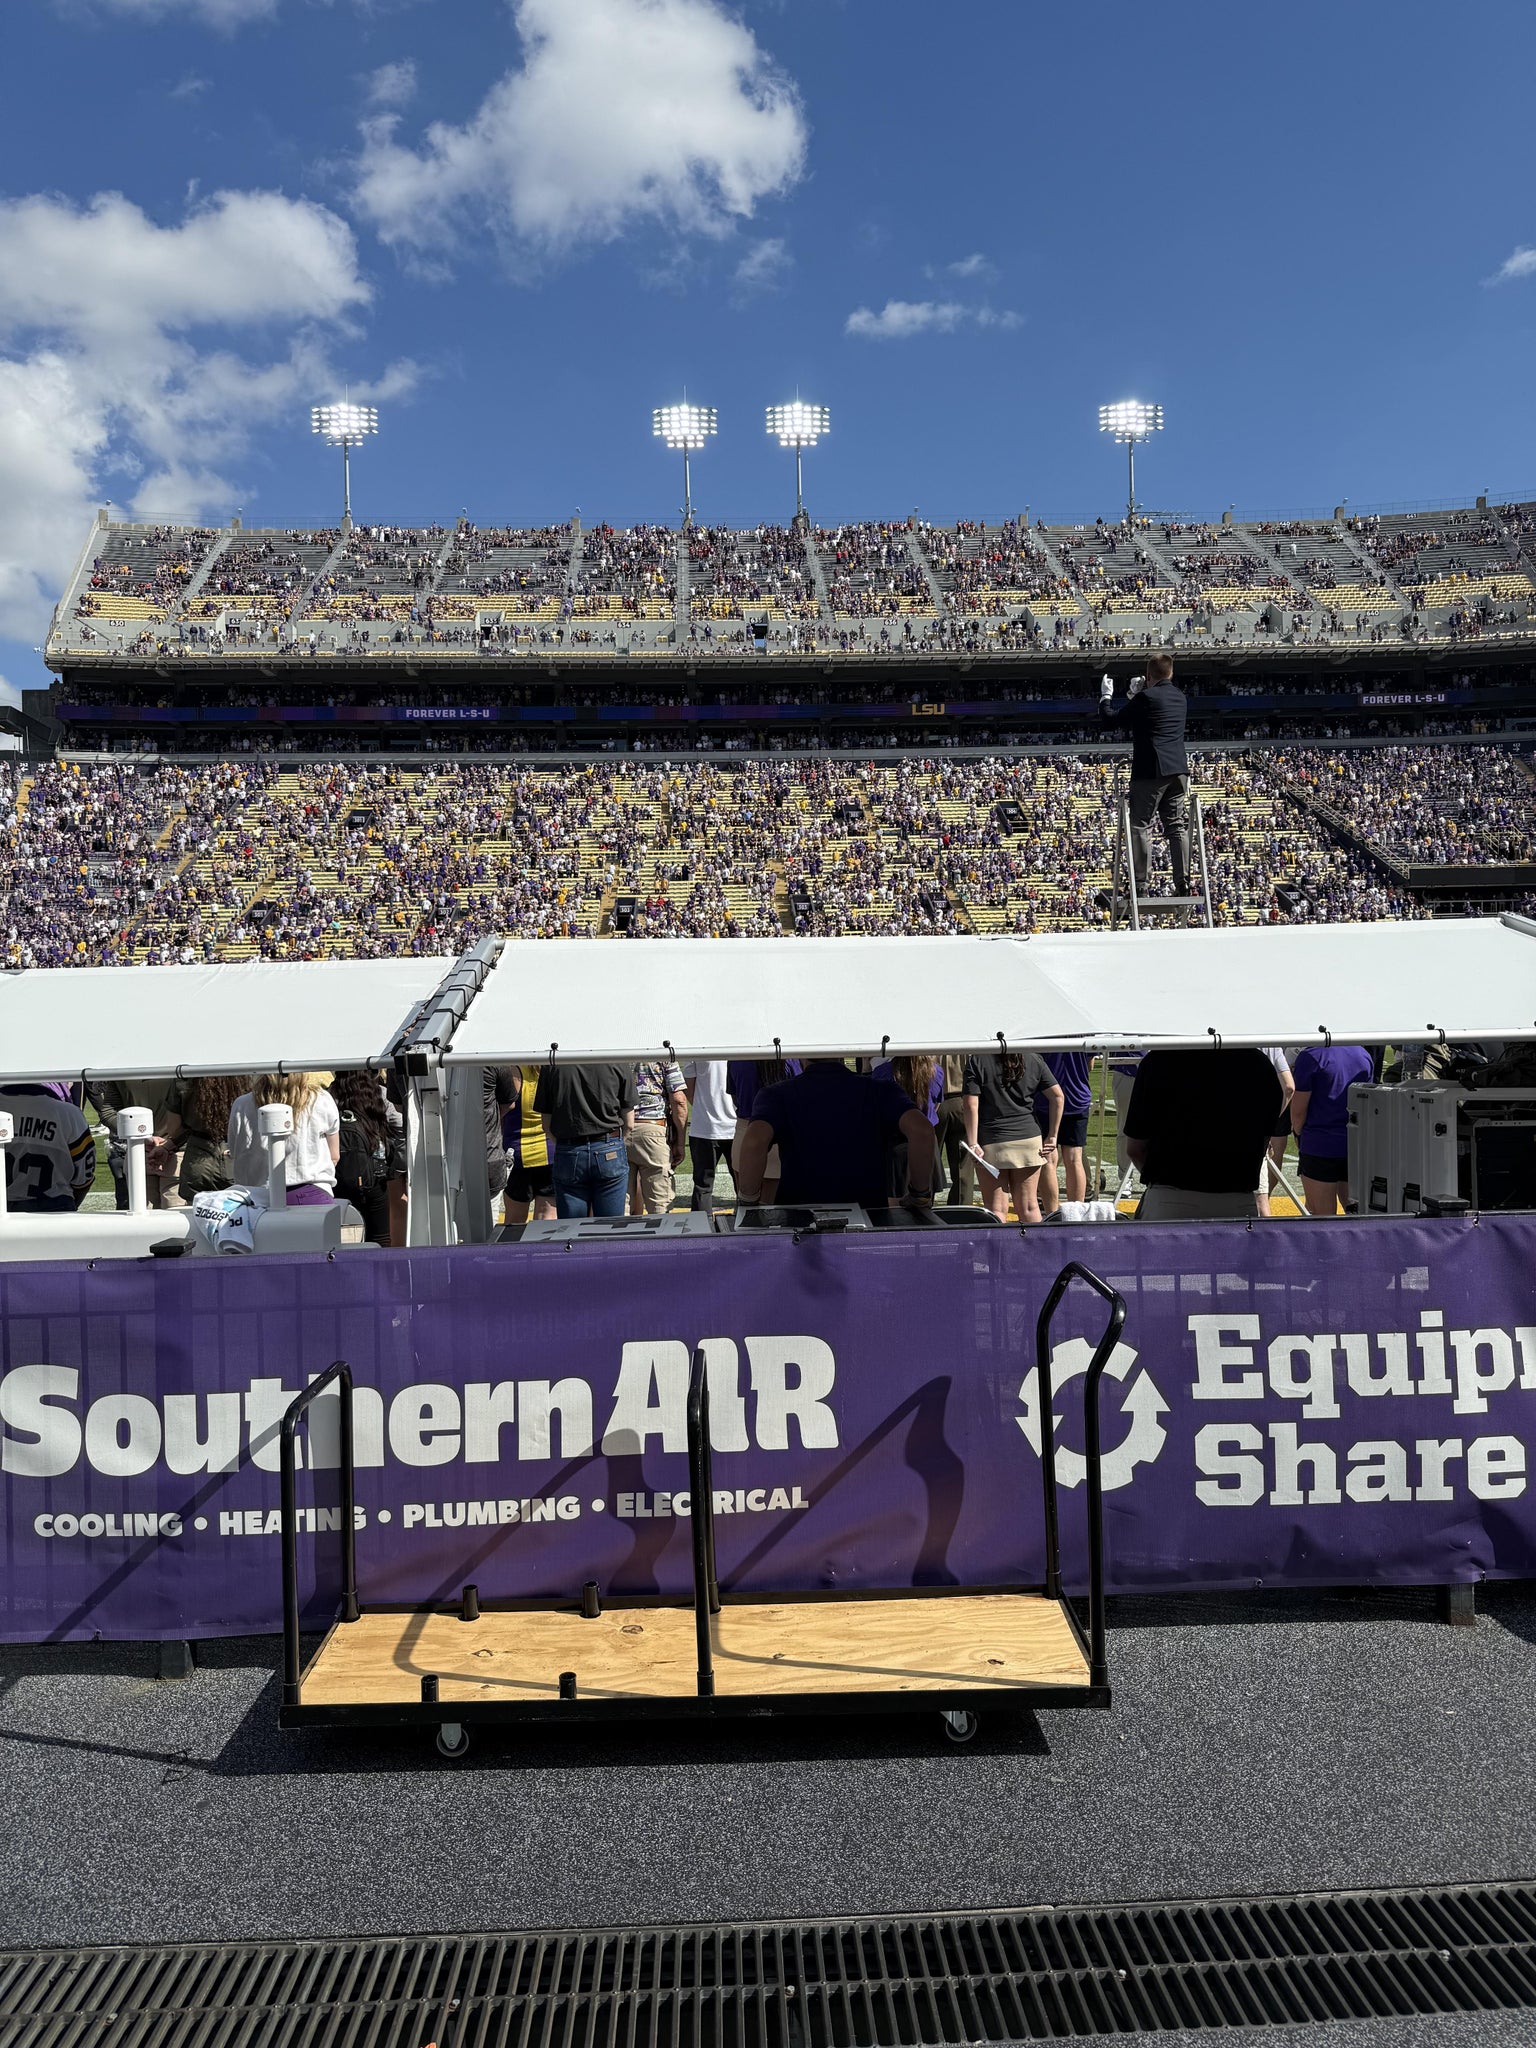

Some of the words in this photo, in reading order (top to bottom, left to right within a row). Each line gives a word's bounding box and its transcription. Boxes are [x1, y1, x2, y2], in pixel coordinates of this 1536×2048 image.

[405, 709, 456, 718] FOREVER
[460, 709, 490, 718] L-S-U
[911, 703, 945, 715] LSU
[1362, 695, 1412, 704] FOREVER
[1415, 694, 1445, 703] L-S-U
[1188, 1311, 1536, 1419] Equip
[1195, 1423, 1527, 1507] Share
[34, 1513, 183, 1538] COOLING
[219, 1507, 367, 1536] HEATING
[403, 1496, 581, 1528] PLUMBING
[617, 1487, 809, 1518] ELECRICAL
